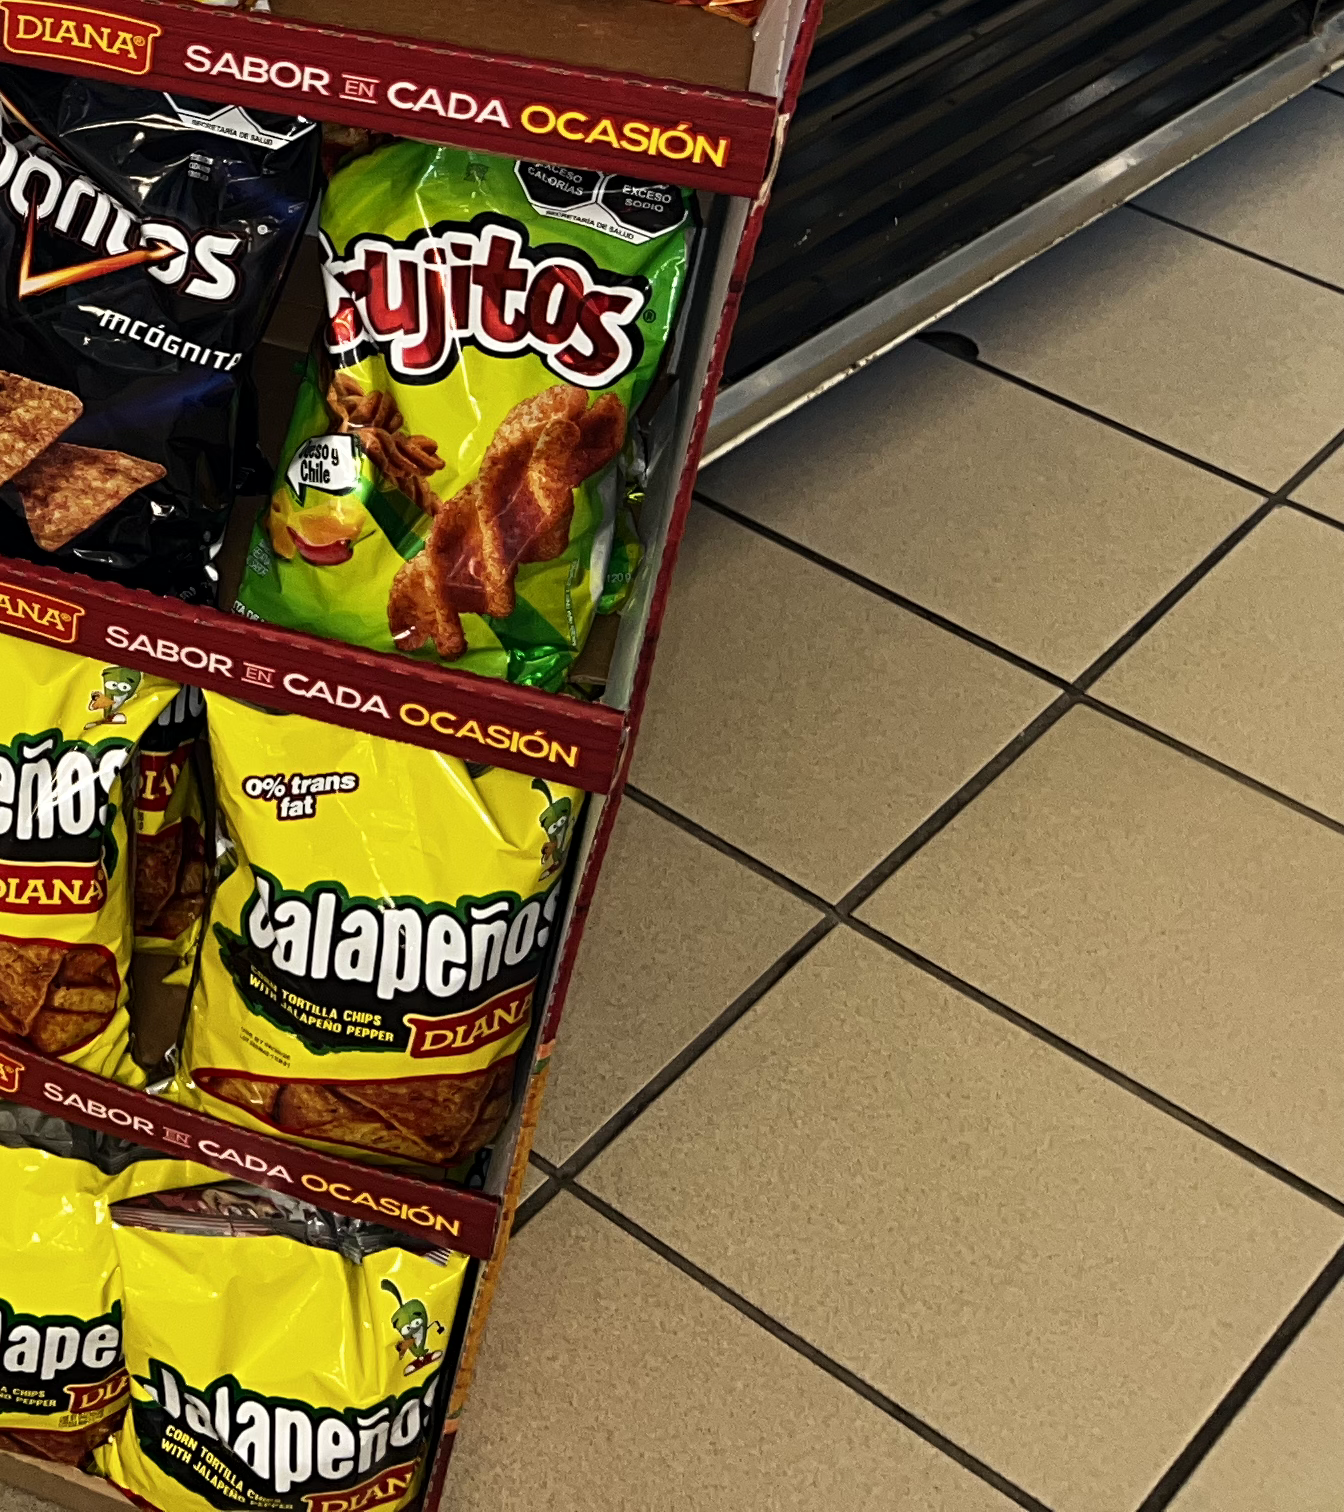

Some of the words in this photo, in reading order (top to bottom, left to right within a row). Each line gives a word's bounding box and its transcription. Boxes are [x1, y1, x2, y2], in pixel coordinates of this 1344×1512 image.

[15, 17, 137, 62] DIANA
[184, 44, 330, 96] SABOR
[344, 78, 377, 101] EN
[387, 80, 511, 128] CADA
[520, 104, 730, 170] OCASIÓN
[527, 167, 584, 197] CALORÍAS
[622, 184, 673, 205] EXCESO
[624, 198, 665, 214] SODIO
[300, 457, 331, 485] Chile
[105, 624, 235, 679] SABOR
[246, 664, 272, 684] EN
[283, 672, 391, 719] CADA
[399, 702, 580, 769] OCASIÓN
[245, 776, 285, 798] 0%
[290, 772, 356, 794] trans
[279, 795, 313, 819] fat
[281, 989, 337, 1019] TORTILLA
[343, 1011, 382, 1026] CHIPS
[424, 993, 533, 1052] DIANA
[346, 1025, 394, 1043] PEPPER
[43, 1081, 157, 1137] SABOR
[164, 1128, 190, 1147] EN
[198, 1139, 294, 1185] CADA
[300, 1172, 462, 1238] OCASIÓN
[160, 1437, 192, 1464] WITH
[165, 1424, 199, 1450] CORN
[199, 1445, 244, 1493] TORTILLA
